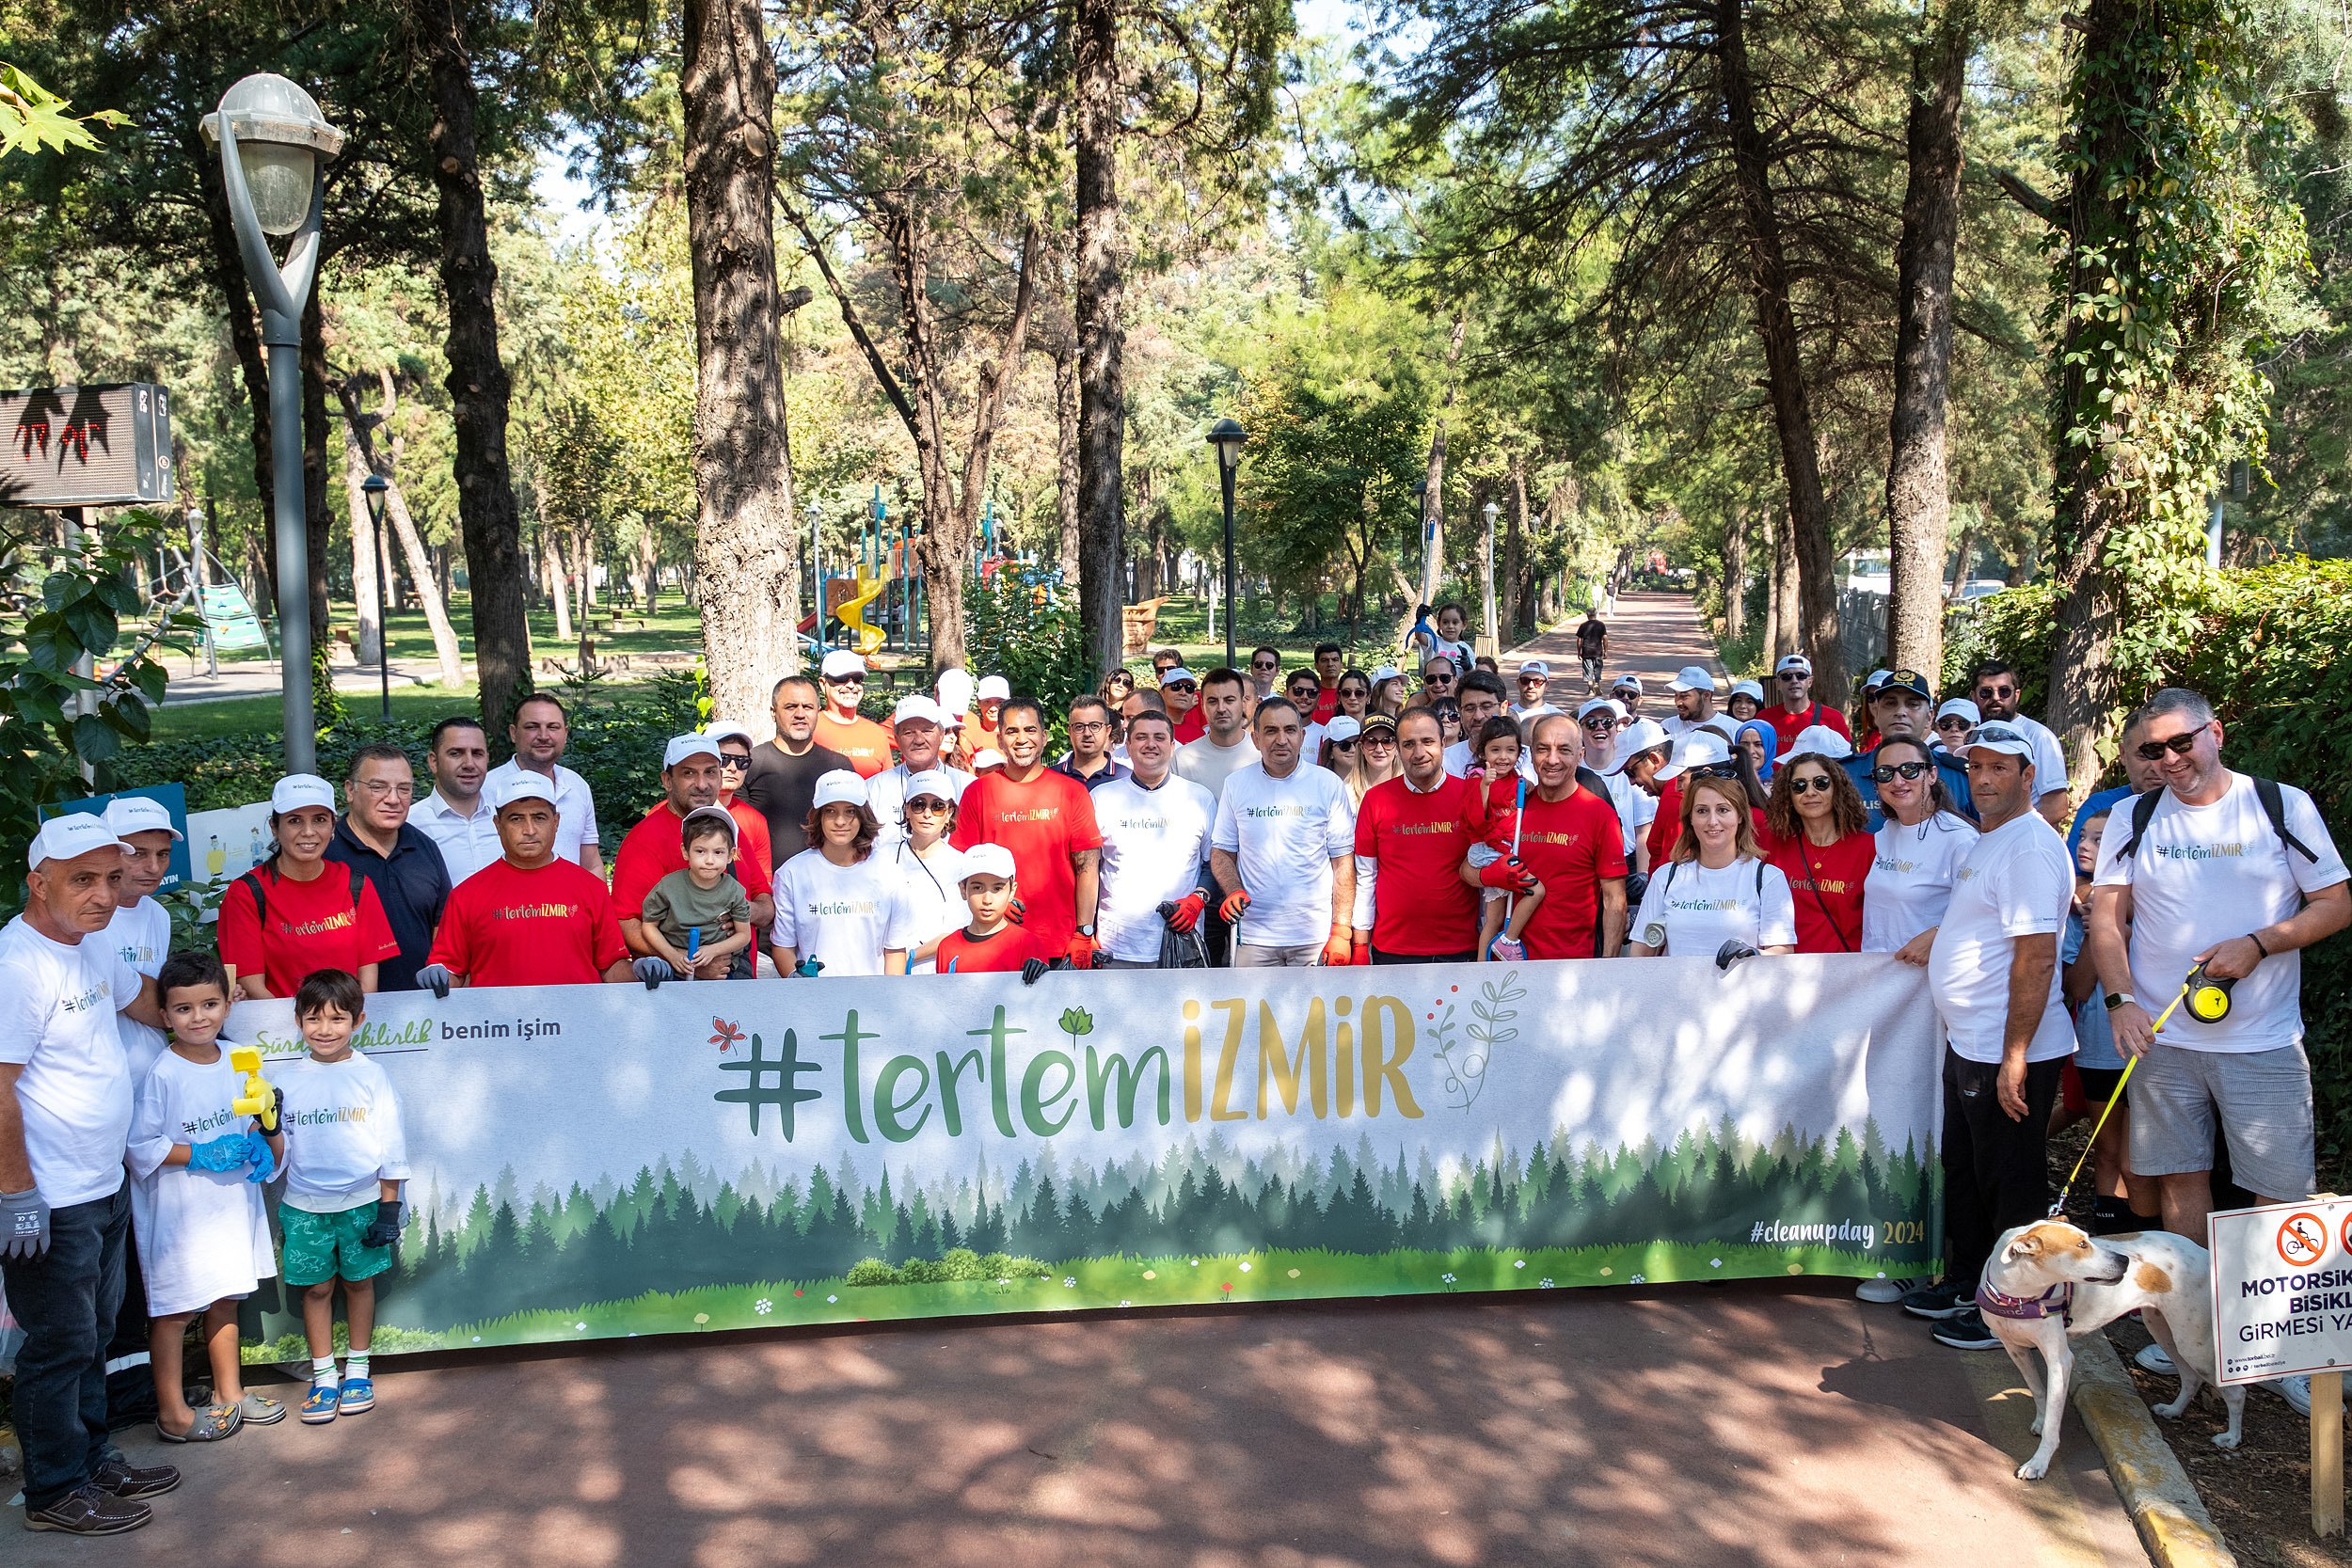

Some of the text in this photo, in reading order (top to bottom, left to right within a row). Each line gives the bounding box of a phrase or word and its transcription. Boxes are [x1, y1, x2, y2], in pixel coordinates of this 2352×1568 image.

[442, 1021, 510, 1040] benim
[516, 1019, 561, 1041] işim
[1750, 1217, 1926, 1250] #cleanupday 2024
